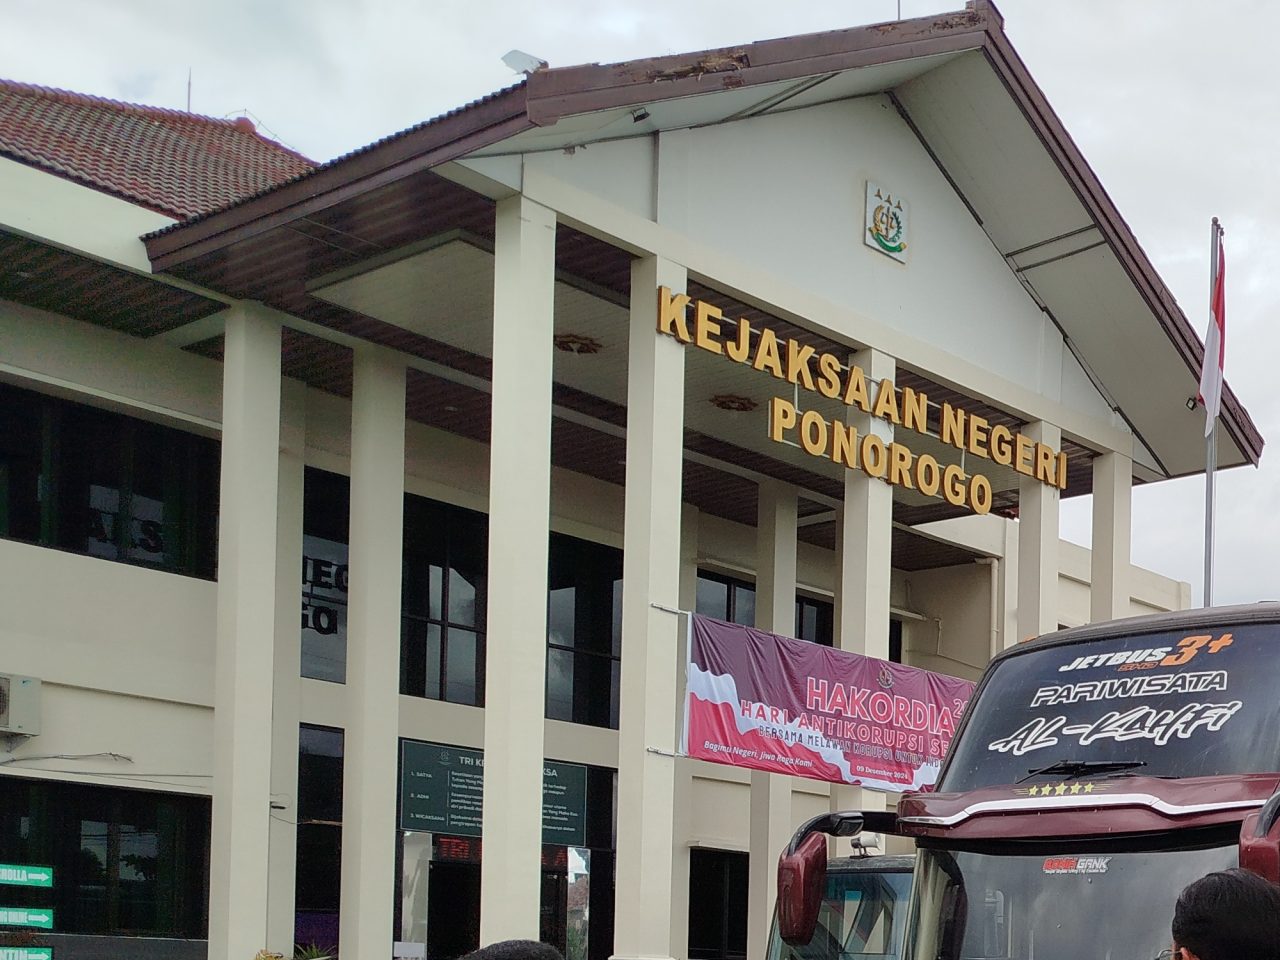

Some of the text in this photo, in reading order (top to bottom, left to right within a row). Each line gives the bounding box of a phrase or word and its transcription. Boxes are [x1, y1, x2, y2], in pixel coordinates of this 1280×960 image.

[657, 285, 1068, 490] KEJAKSAAN NEGERI
[770, 396, 993, 516] PONOROGO
[1058, 647, 1173, 672] JETBUS
[806, 676, 955, 737] HAKORDIA
[1030, 671, 1228, 707] PARIWISATA
[704, 740, 732, 753] Bagimu
[741, 700, 789, 726] HARI
[798, 713, 924, 753] ANTIKORUPSI
[759, 725, 803, 743] BERSAMA
[807, 735, 851, 754] MELAWAN
[853, 742, 893, 761] KORUPSI
